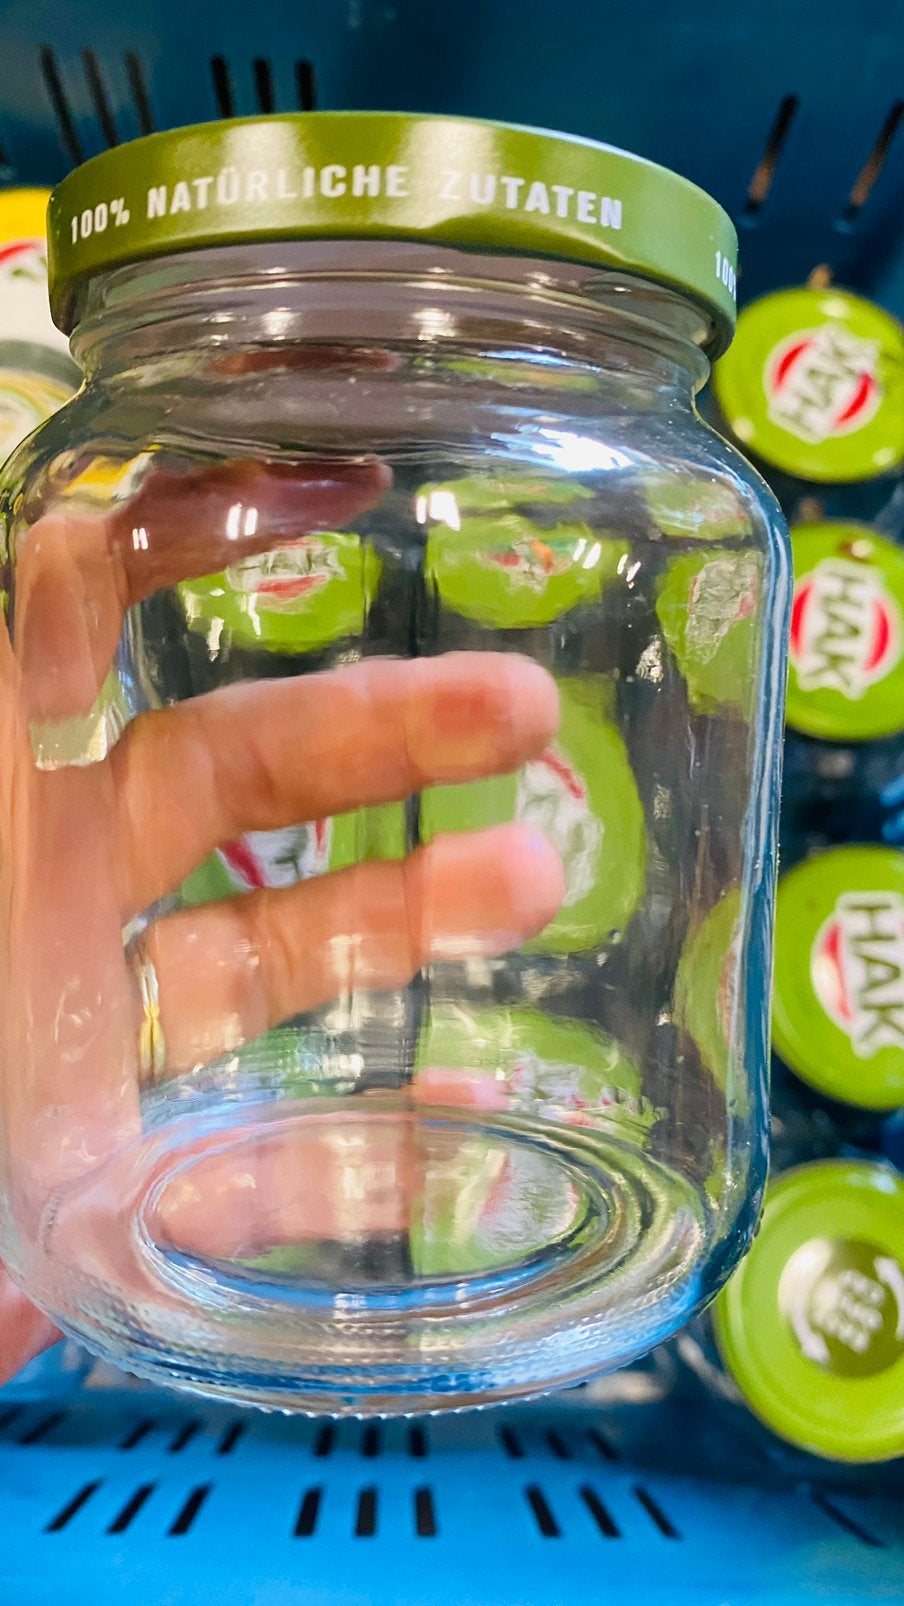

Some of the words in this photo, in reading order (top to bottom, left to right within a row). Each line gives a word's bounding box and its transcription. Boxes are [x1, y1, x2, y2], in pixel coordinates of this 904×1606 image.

[70, 198, 131, 245] 100%
[146, 164, 411, 219] NATÜRLICHE
[438, 171, 624, 231] ZUTATEN
[802, 564, 868, 694] HAK
[840, 896, 904, 1048] HAK
